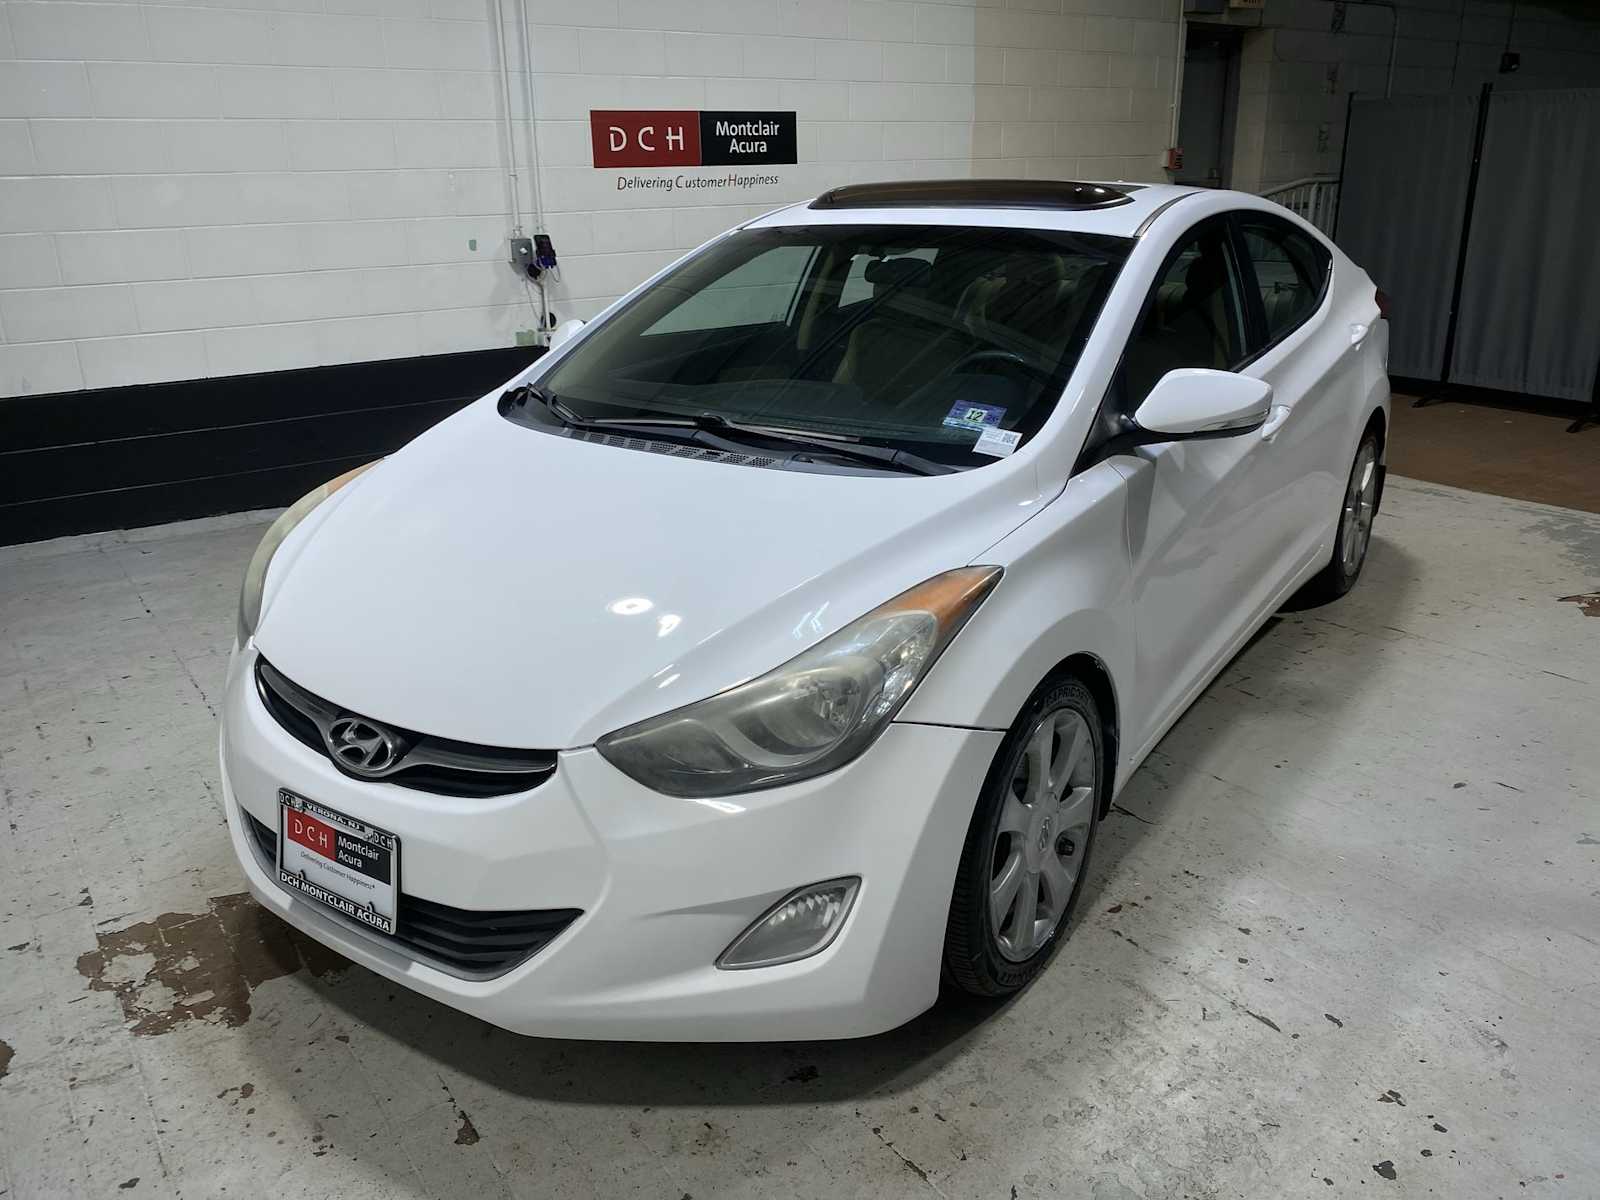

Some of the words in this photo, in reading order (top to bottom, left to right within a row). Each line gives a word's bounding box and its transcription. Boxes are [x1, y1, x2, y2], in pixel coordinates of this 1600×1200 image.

[715, 120, 780, 137] Montclair
[609, 126, 684, 152] DCH
[729, 138, 768, 154] Acura
[617, 176, 673, 191] Delivering
[676, 175, 727, 189] Customer
[728, 174, 779, 188] Happiness
[966, 410, 984, 422] 12
[294, 819, 328, 849] DCH
[374, 832, 393, 849] DCH
[337, 835, 380, 861] Montclair
[337, 850, 362, 869] Acura
[280, 872, 300, 889] DCH
[301, 881, 355, 915] MONTCLAIR
[356, 909, 390, 932] ACURA
